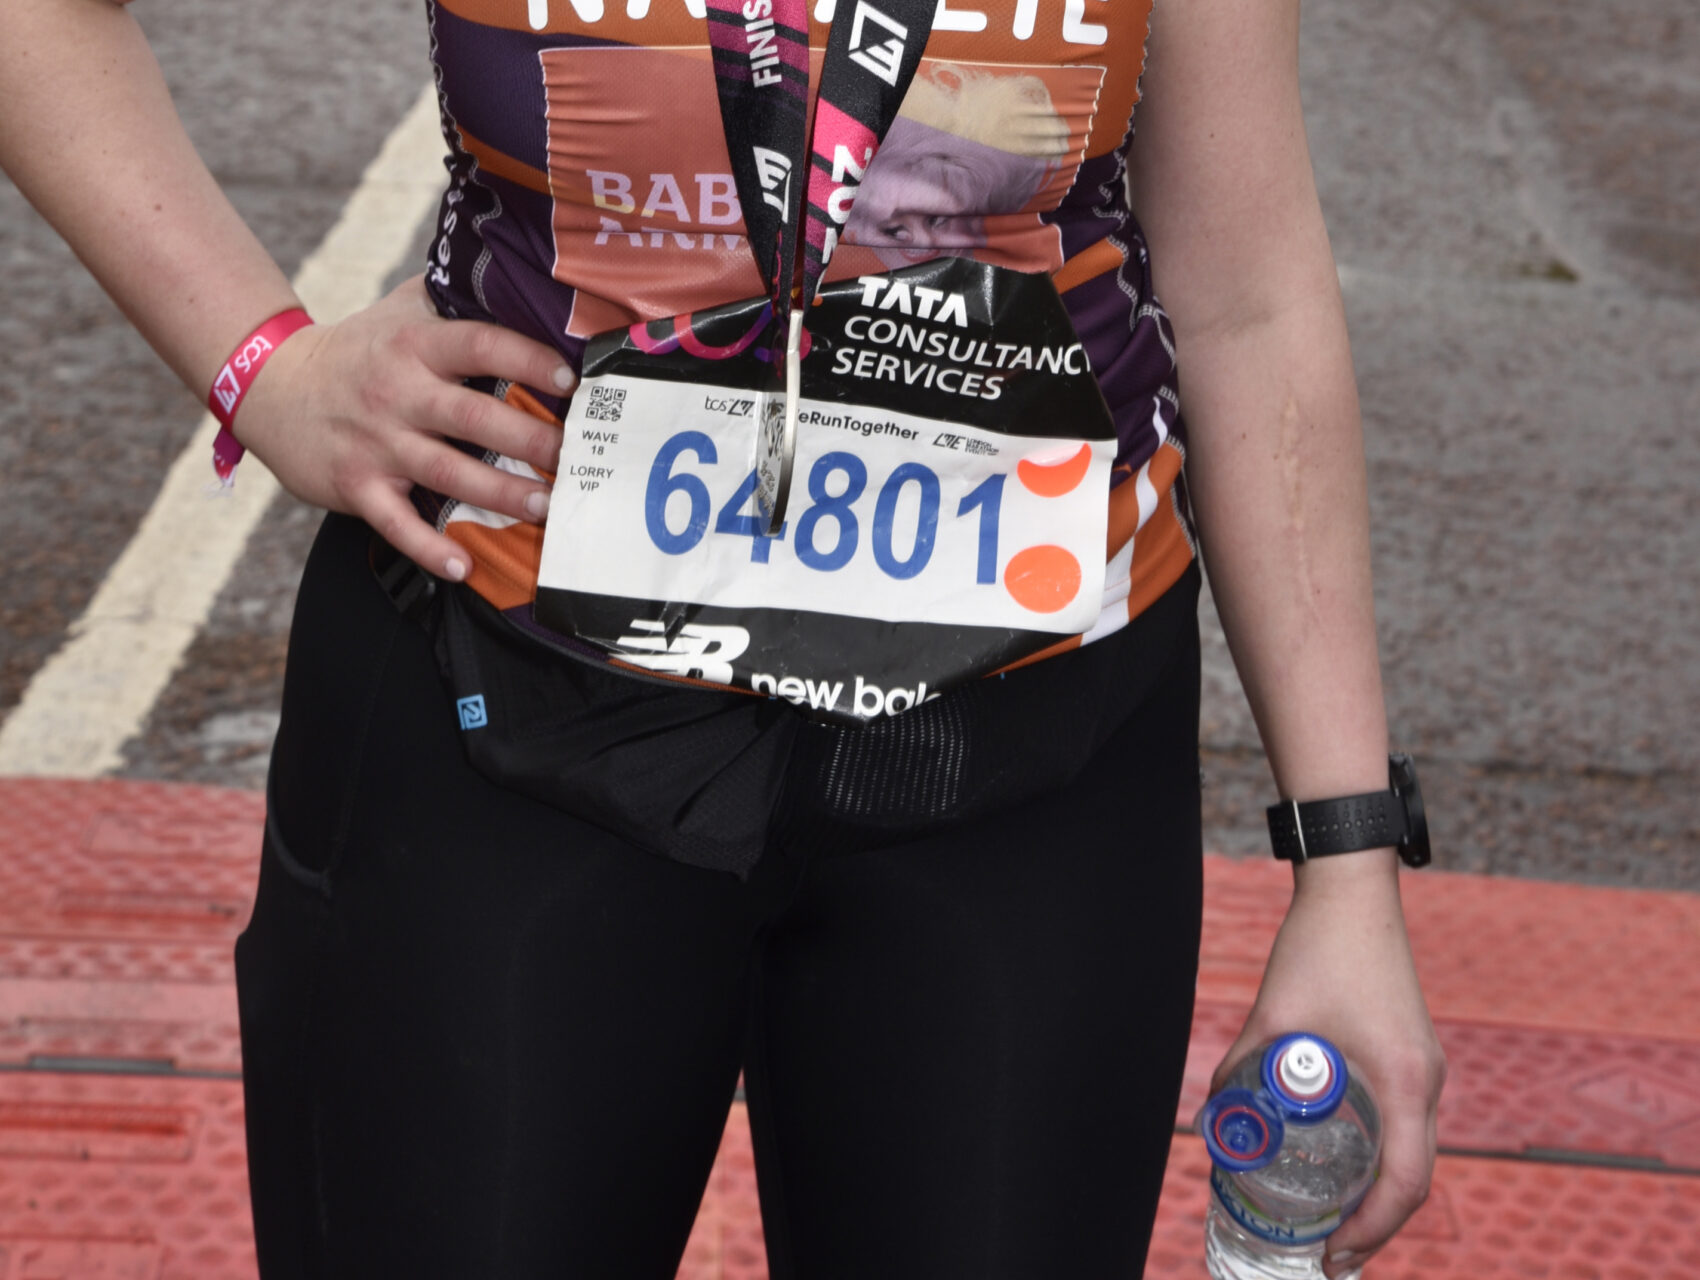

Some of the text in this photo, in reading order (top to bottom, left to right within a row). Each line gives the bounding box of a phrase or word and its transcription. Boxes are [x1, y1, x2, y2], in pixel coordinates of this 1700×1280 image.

[857, 275, 969, 329] TATA
[234, 335, 273, 375] tcs
[843, 315, 1091, 376] CONSULTANC
[831, 347, 1005, 401] SERVICES
[582, 429, 620, 444] WAVE
[591, 444, 605, 456] 18
[569, 464, 615, 479] LORRY
[579, 480, 600, 492] VIP
[644, 430, 1008, 586] 64801
[751, 672, 942, 718] new bal
